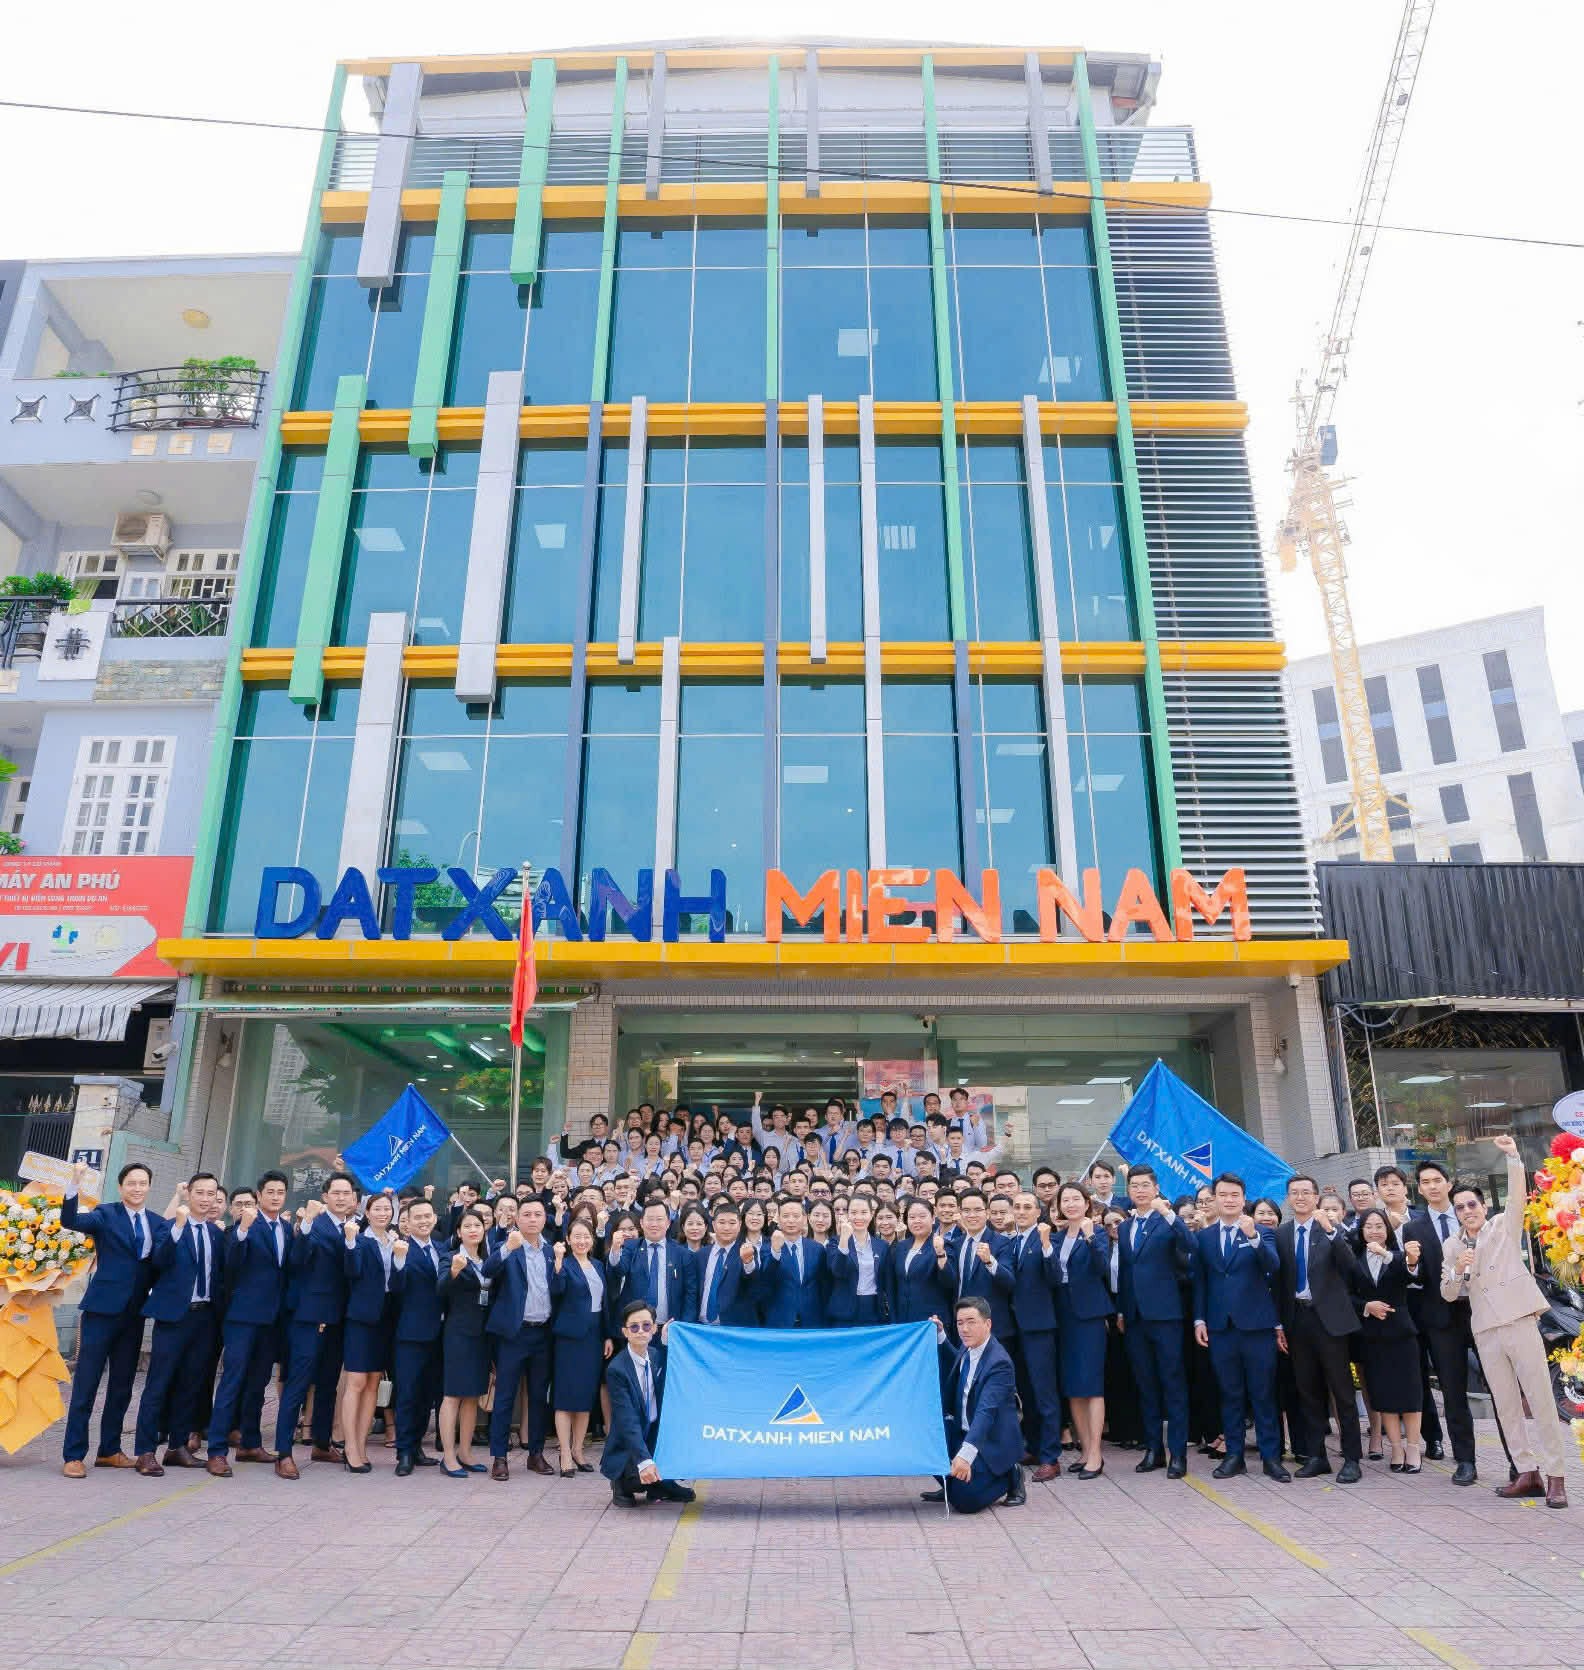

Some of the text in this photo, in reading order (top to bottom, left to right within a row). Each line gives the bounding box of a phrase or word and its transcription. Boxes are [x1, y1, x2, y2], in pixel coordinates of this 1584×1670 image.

[40, 873, 72, 889] AN
[76, 869, 120, 889] PHÚ
[254, 867, 1252, 943] DATXANH MIEN NAM
[373, 1152, 402, 1181] DATXANH
[1136, 1130, 1189, 1179] DATXANH
[702, 1425, 890, 1445] DATXANH MIEN NAM
